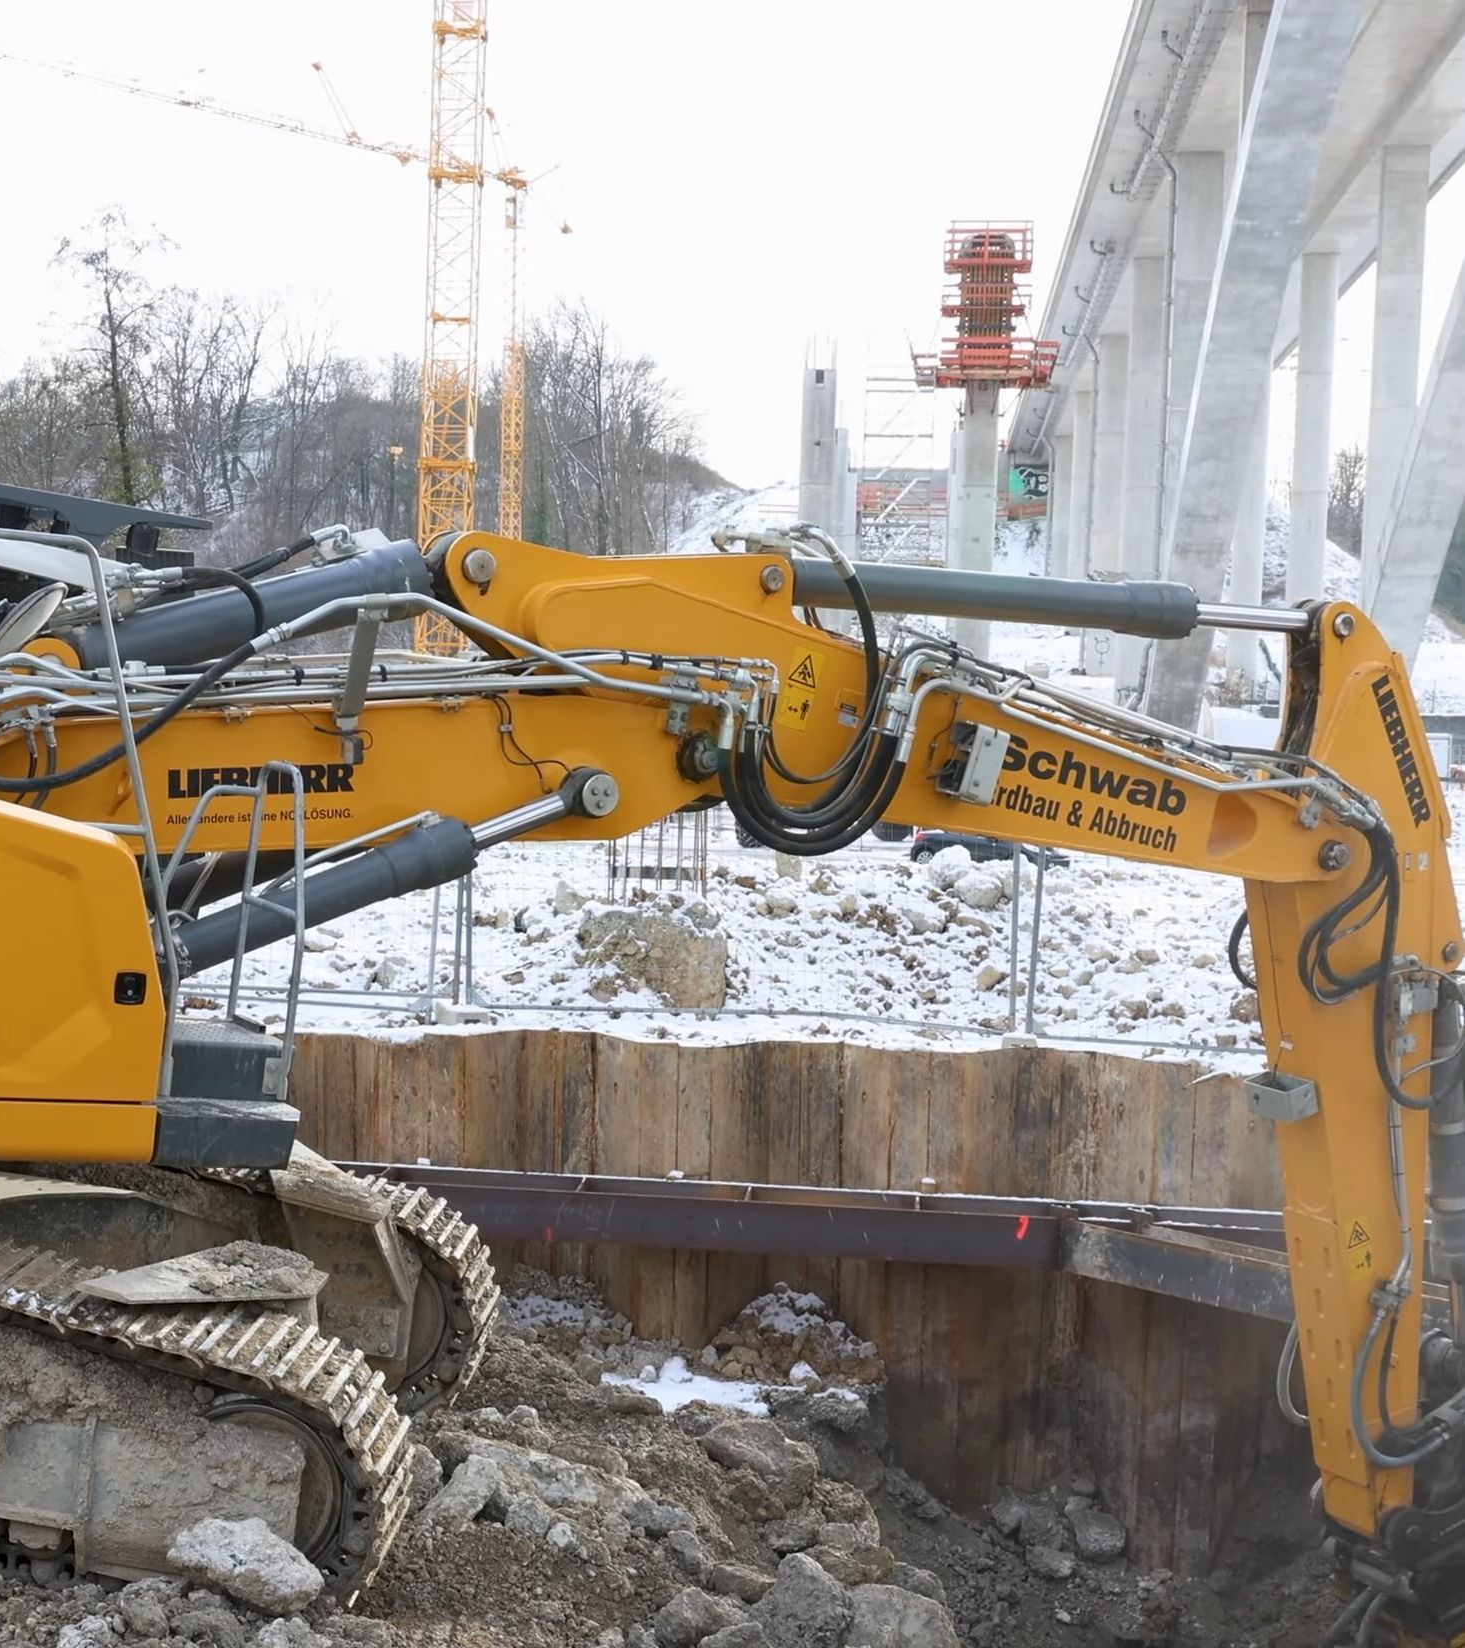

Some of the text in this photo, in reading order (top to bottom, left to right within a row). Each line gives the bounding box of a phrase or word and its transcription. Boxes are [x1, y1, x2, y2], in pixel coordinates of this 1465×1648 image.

[1001, 733, 1187, 816] Schwab
[1371, 674, 1432, 829] LIEBHERR
[237, 811, 251, 823] ist
[990, 780, 1178, 853] rdbau & Abbruch
